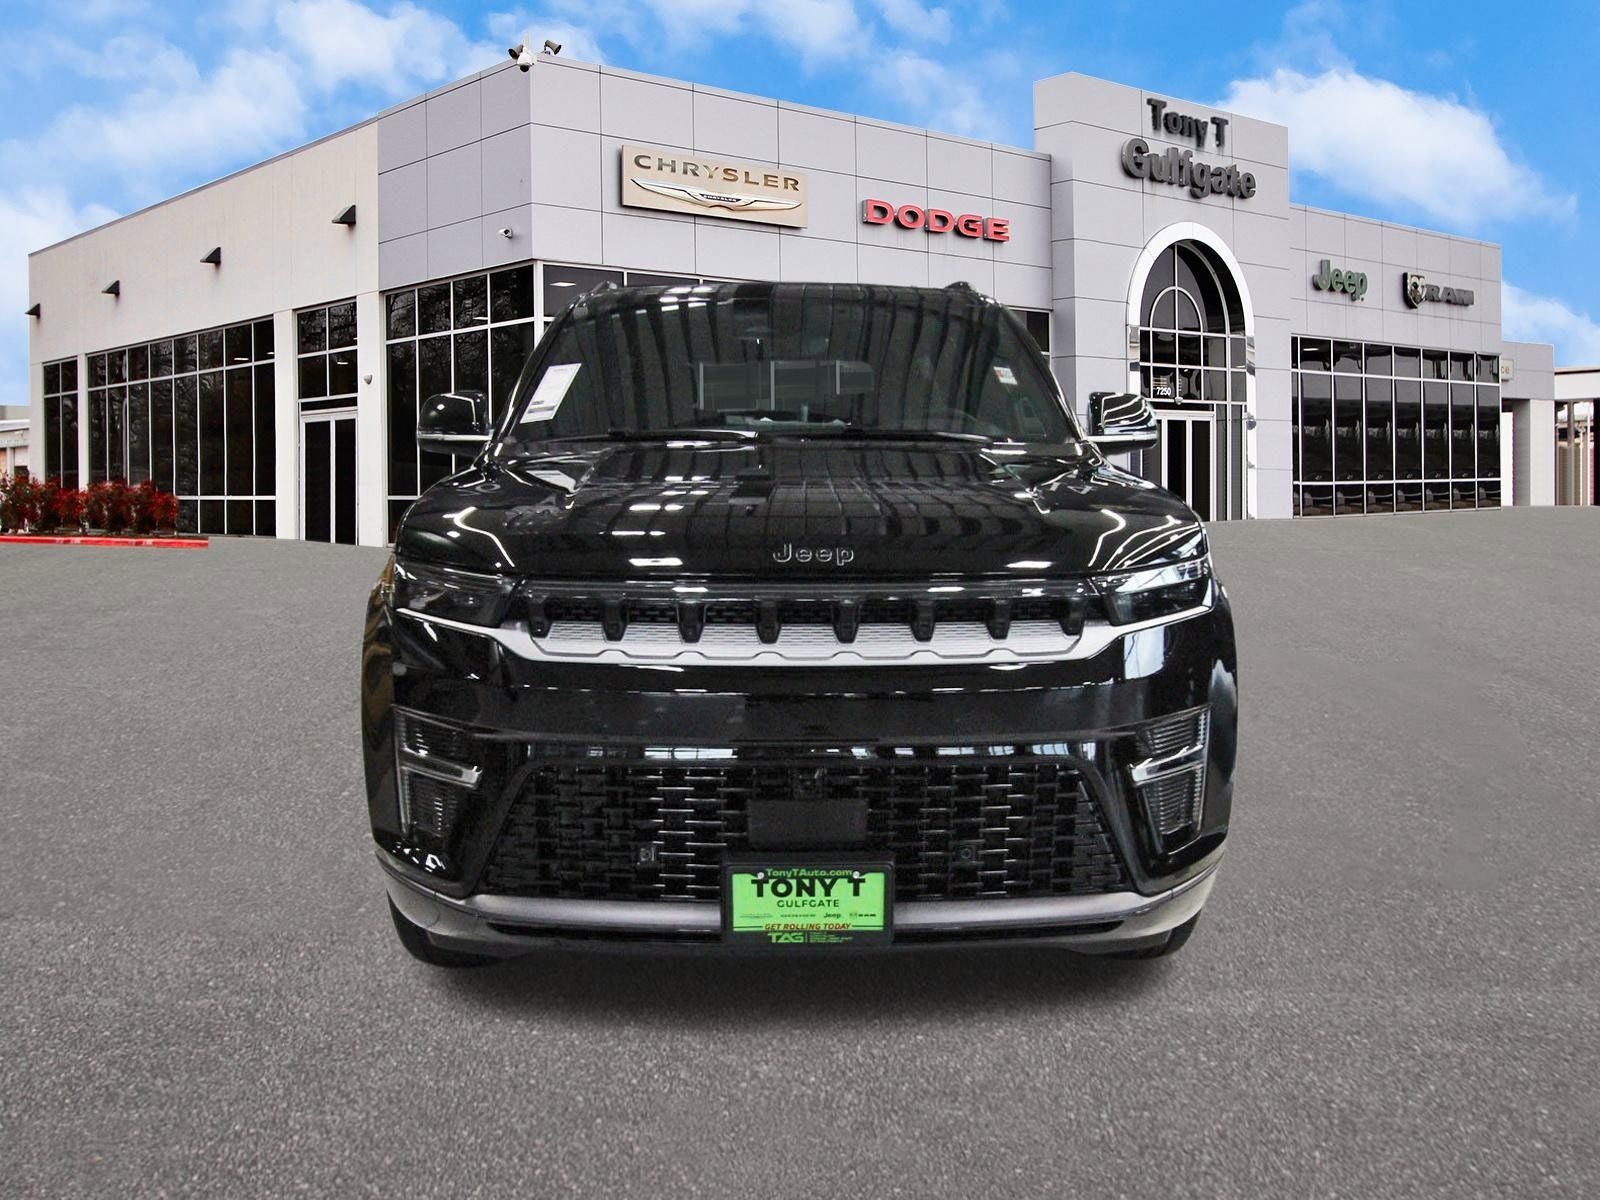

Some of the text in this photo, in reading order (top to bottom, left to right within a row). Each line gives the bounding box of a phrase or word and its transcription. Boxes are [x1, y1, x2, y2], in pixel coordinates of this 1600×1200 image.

[1147, 98, 1229, 147] Tony T
[633, 153, 801, 193] CHRYSLER
[1122, 138, 1257, 199] Gulfgate
[862, 198, 1011, 243] DODGE
[1312, 259, 1368, 302] Jeep
[1424, 284, 1475, 306] RAM
[1156, 387, 1172, 396] 7250
[772, 542, 855, 566] Jeep
[766, 868, 852, 879] TonyTAuto.com
[751, 877, 866, 898] TONY T
[777, 900, 840, 908] GULFGATE
[823, 922, 852, 930] TODAY
[767, 932, 805, 943] TAG
